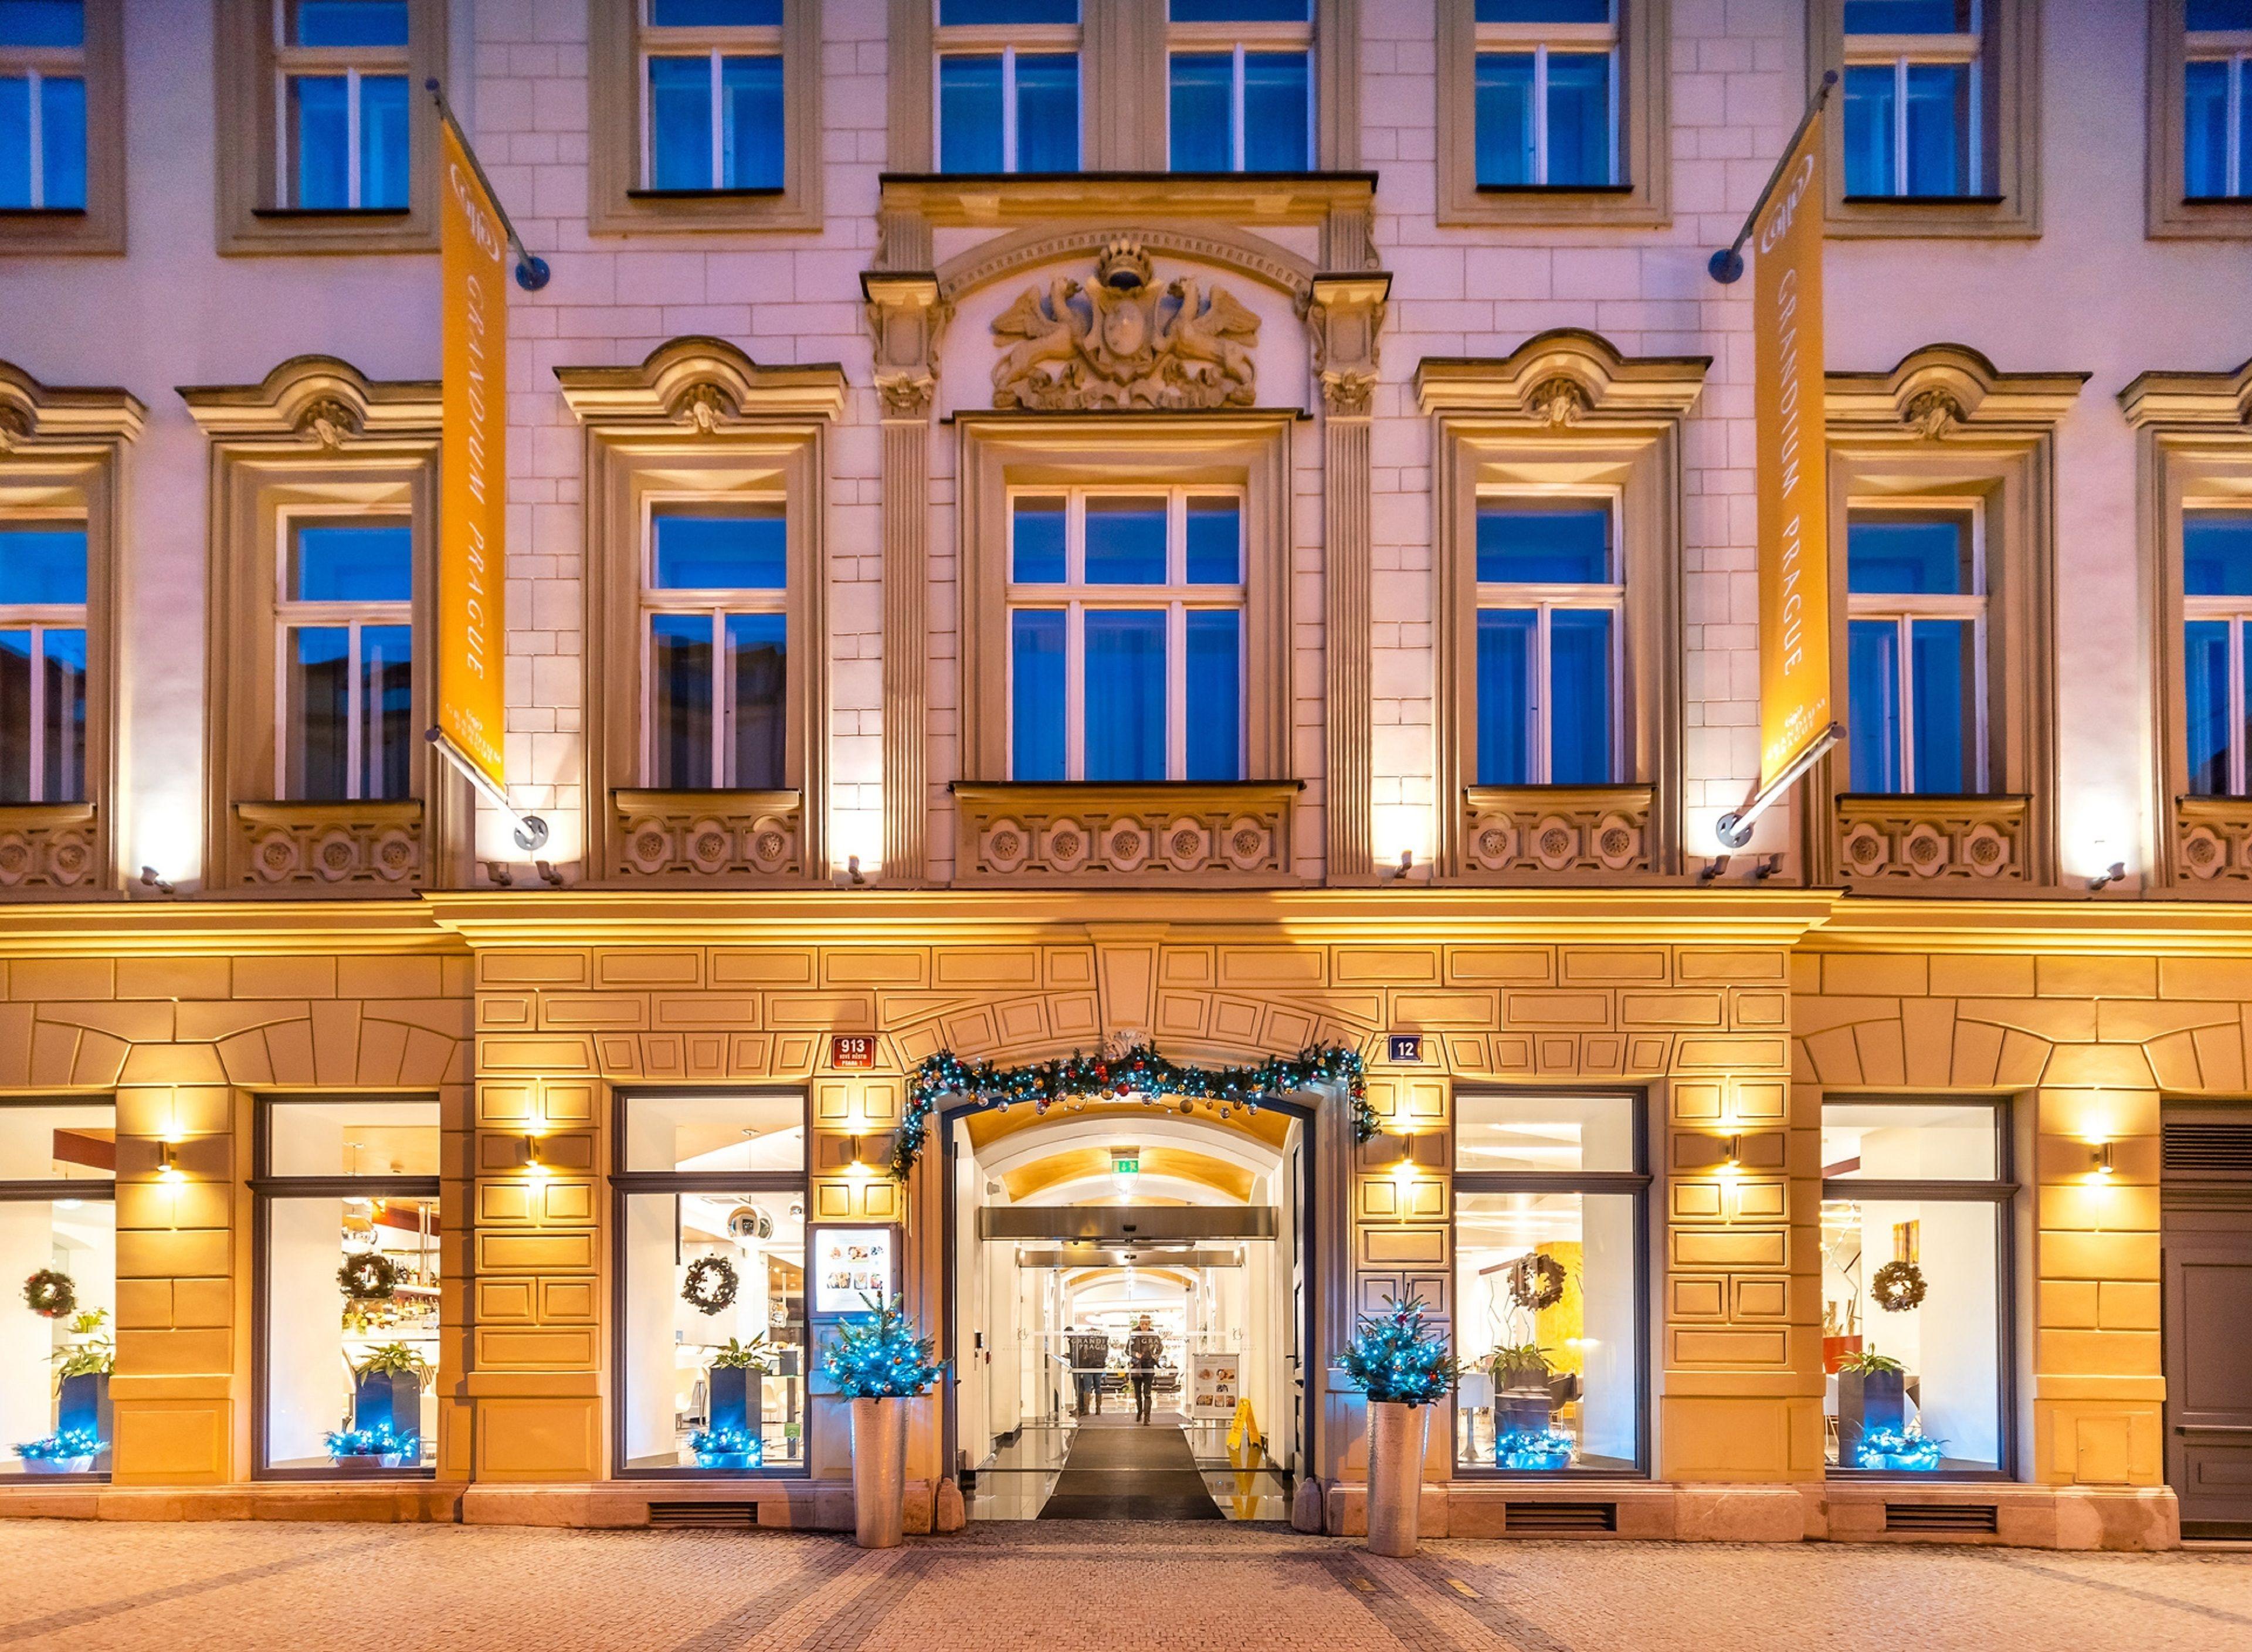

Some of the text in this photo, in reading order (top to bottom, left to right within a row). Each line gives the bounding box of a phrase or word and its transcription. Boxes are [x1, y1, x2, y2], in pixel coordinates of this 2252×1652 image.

[467, 274, 484, 680] GRANDIUM PRAGUE
[1779, 269, 1802, 676] GRANDIUM PRAGUE
[841, 1039, 865, 1053] 913
[1398, 1042, 1414, 1056] 12
